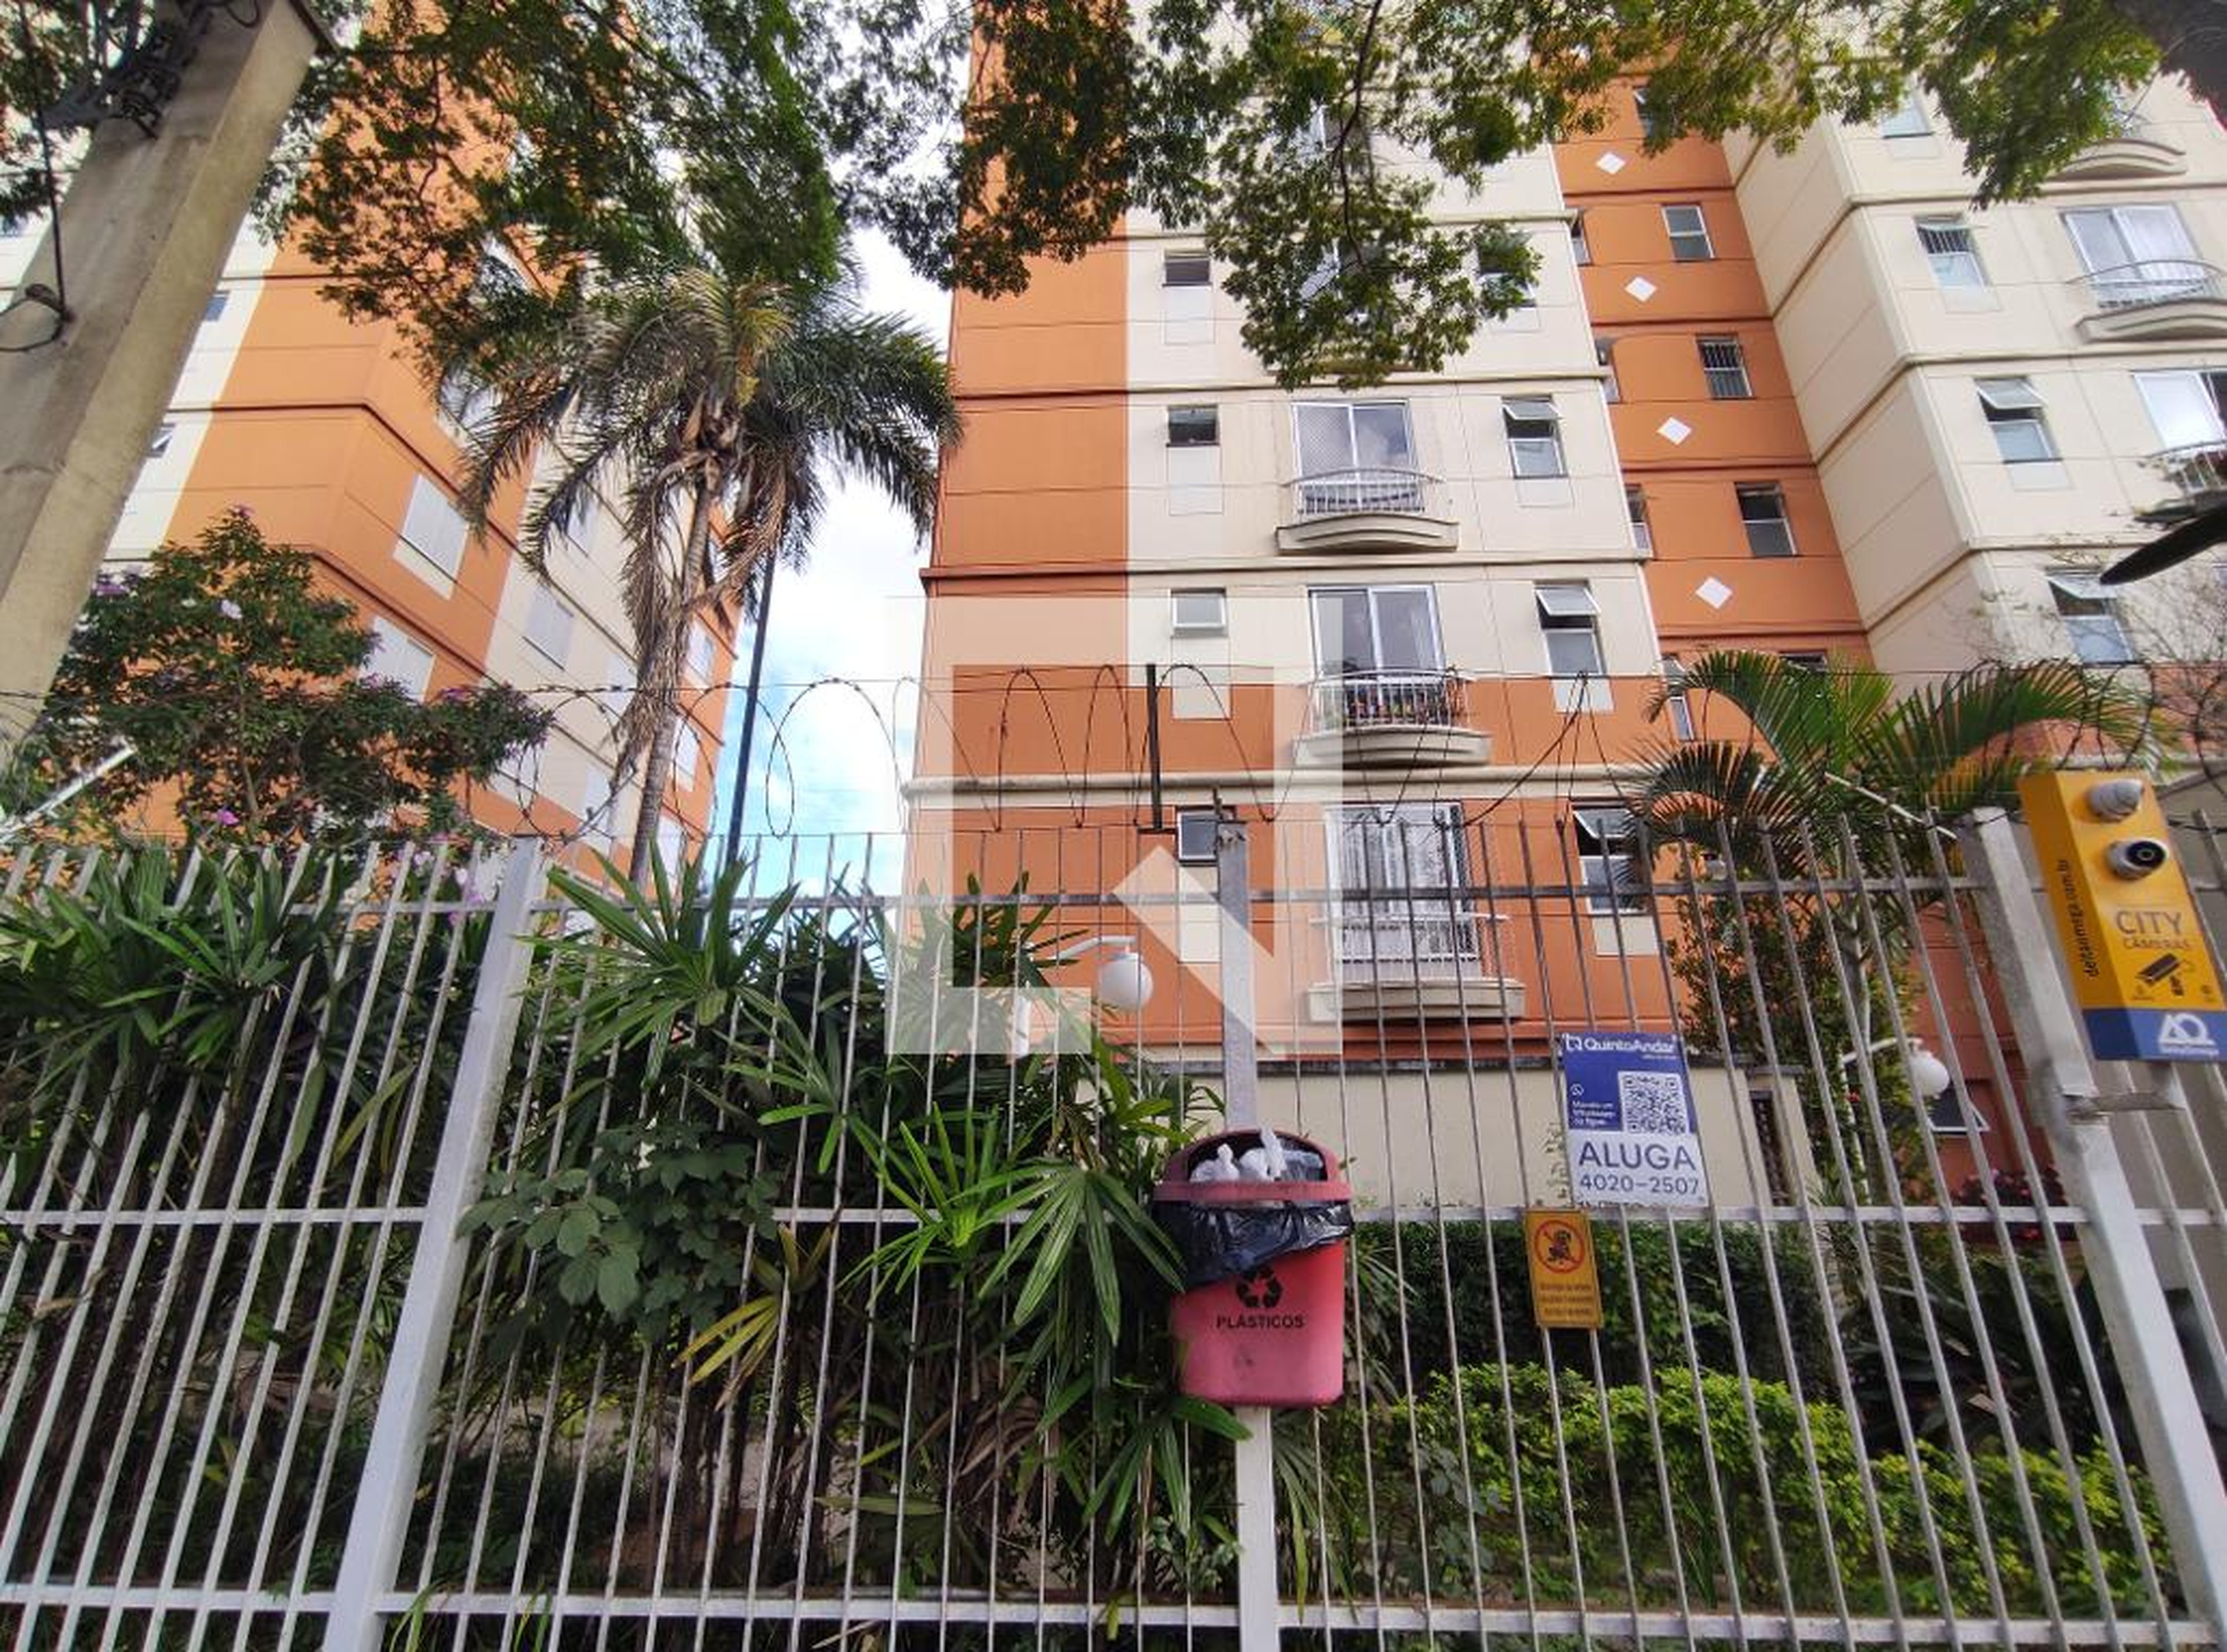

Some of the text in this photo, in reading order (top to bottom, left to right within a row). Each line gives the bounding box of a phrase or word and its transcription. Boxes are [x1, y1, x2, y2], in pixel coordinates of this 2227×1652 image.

[2116, 910, 2182, 936] CITY
[1584, 1037, 1675, 1053] QuintoAndar
[1579, 1141, 1696, 1171] ALUGA
[1580, 1174, 1699, 1196] 4020-2507
